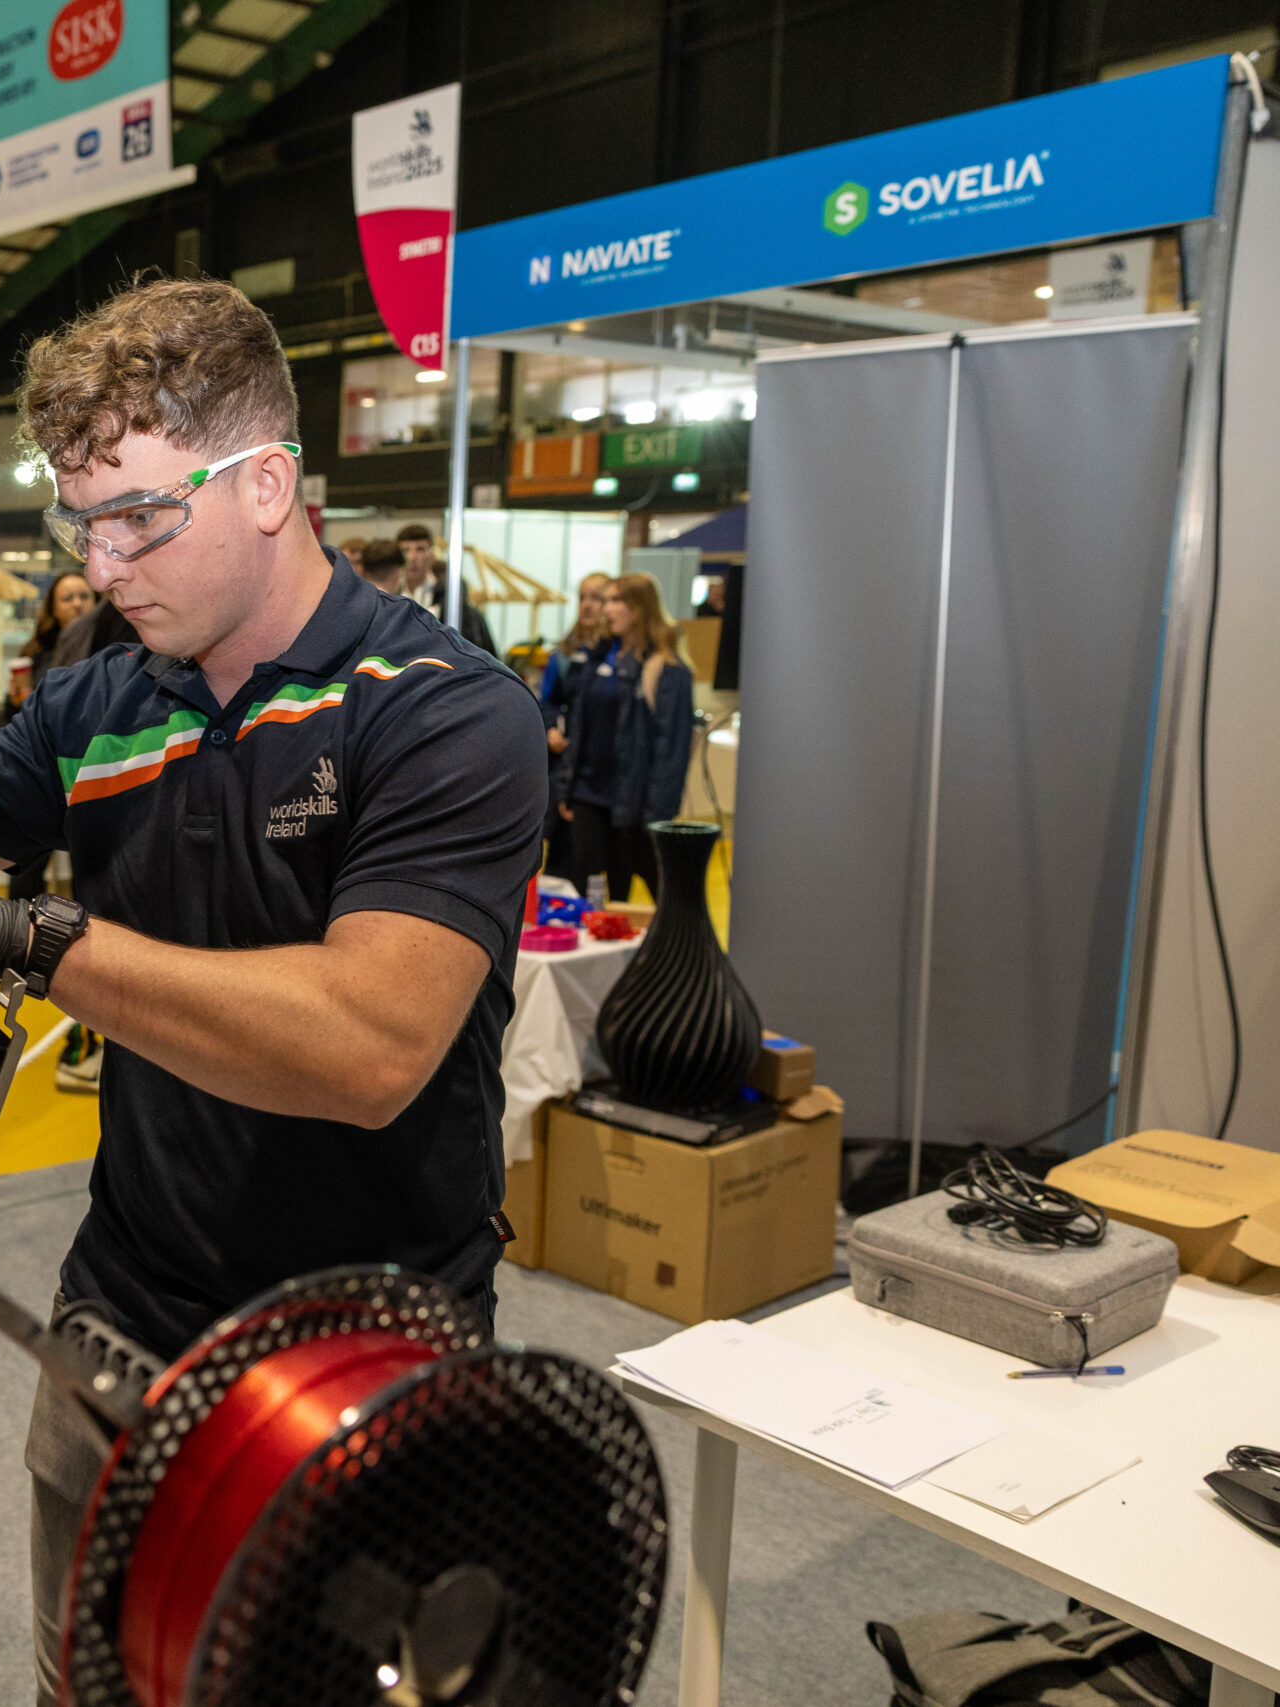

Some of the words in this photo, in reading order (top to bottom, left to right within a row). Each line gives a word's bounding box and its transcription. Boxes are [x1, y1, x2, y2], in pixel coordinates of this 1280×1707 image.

[55, 0, 116, 63] SISK
[878, 154, 1045, 216] SOVELIA
[529, 255, 551, 286] N
[562, 229, 673, 279] NAVIATE
[623, 430, 677, 464] EXIT
[265, 816, 307, 838] Ireland
[270, 795, 338, 819] worldskills
